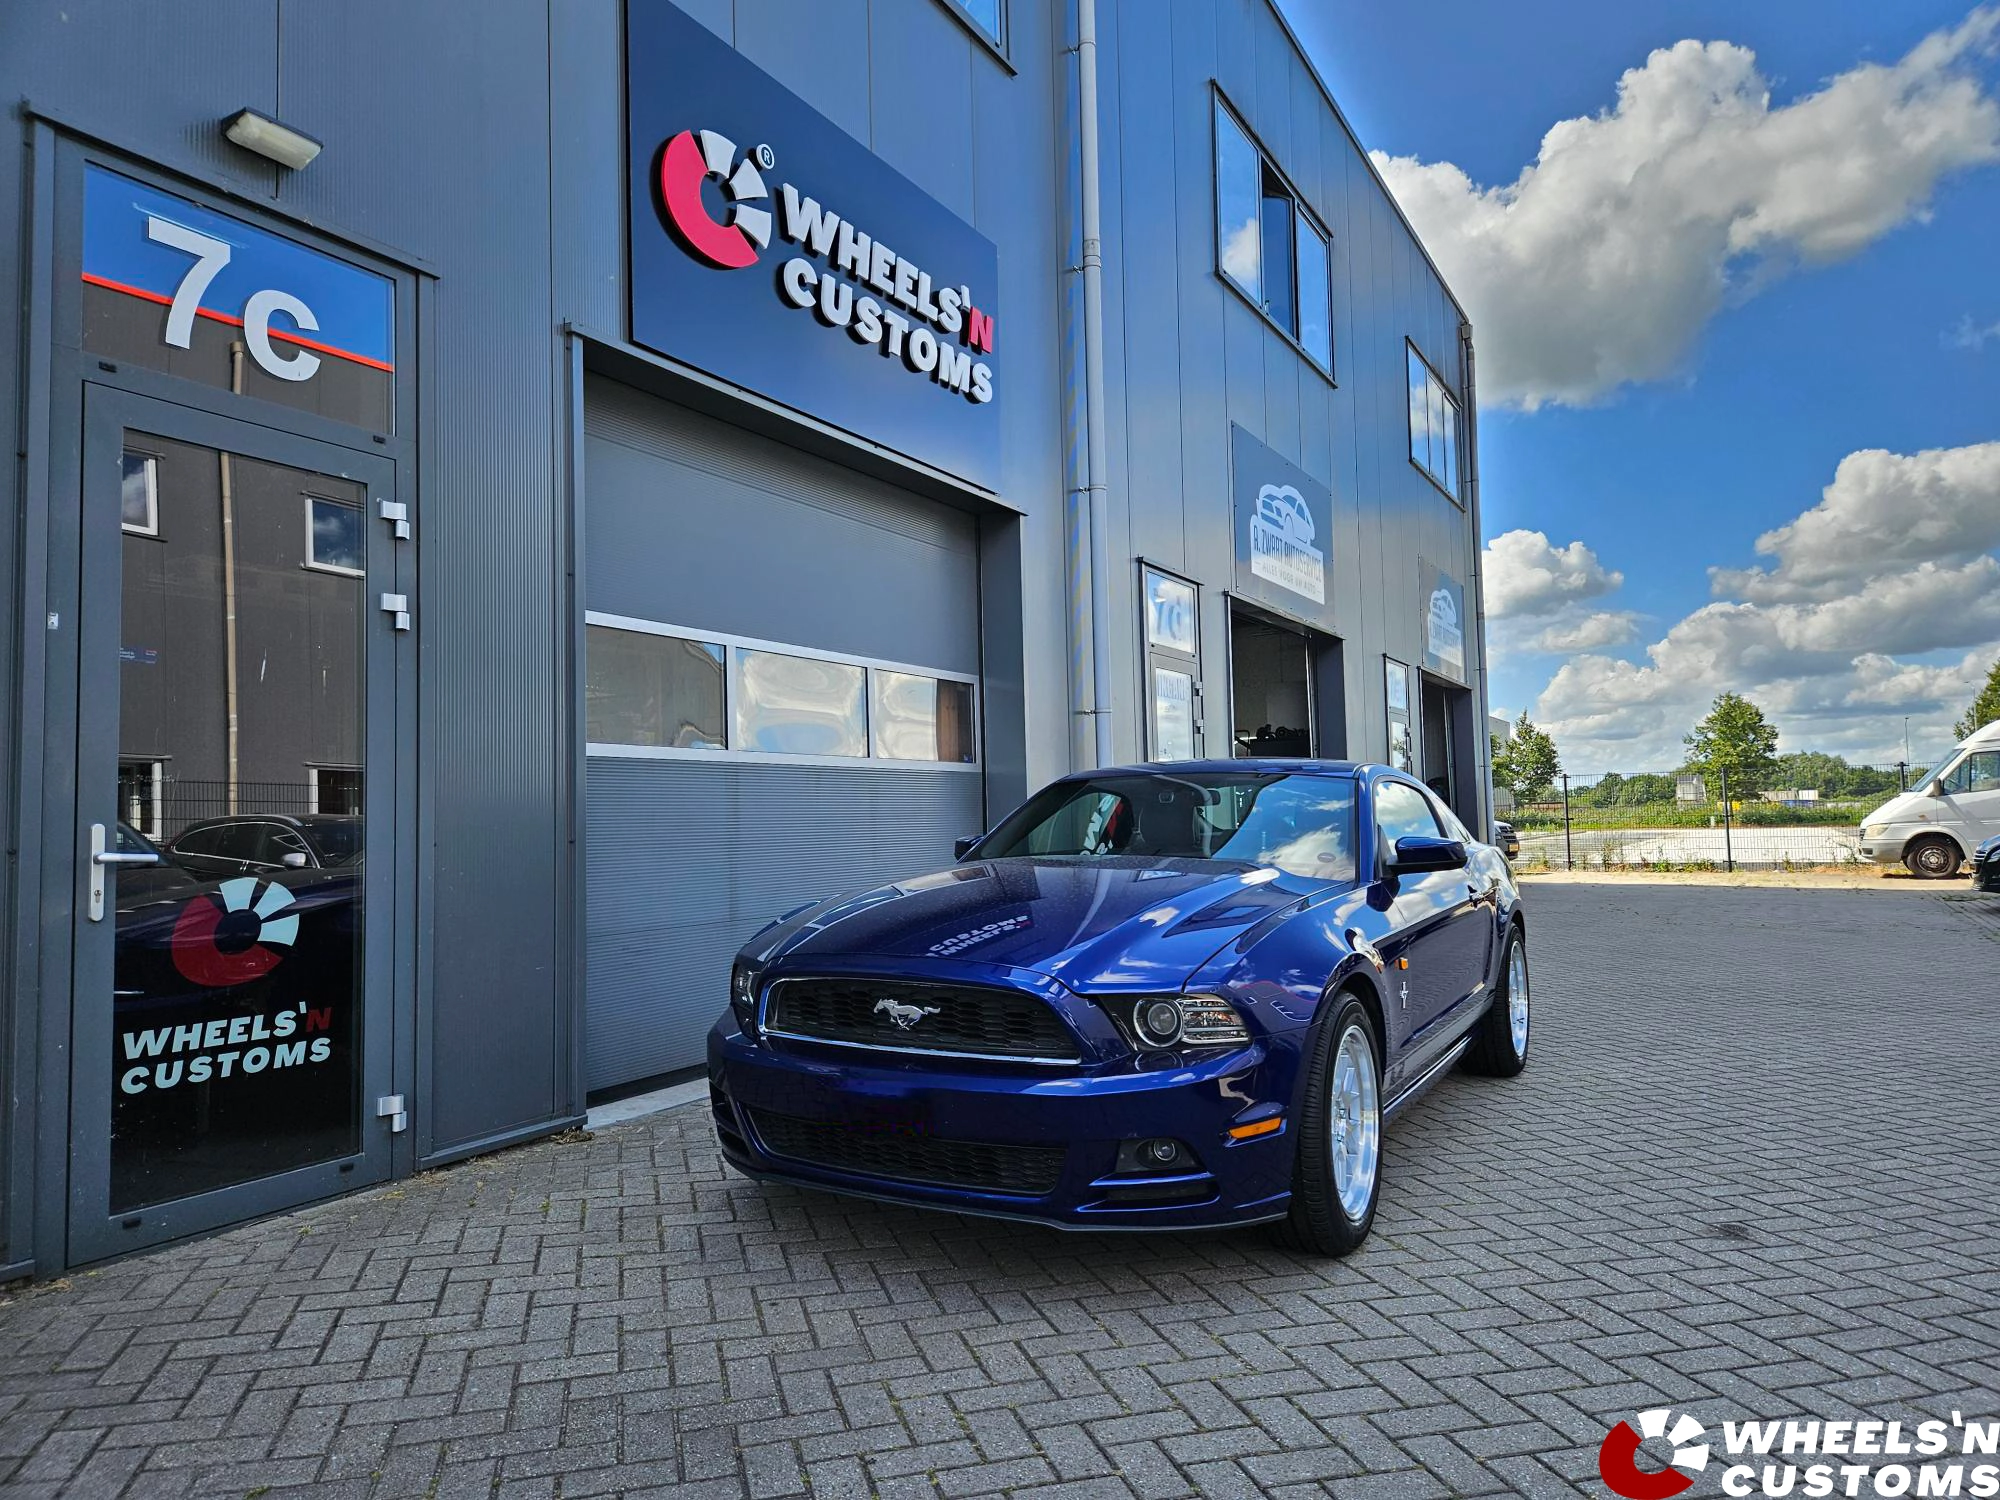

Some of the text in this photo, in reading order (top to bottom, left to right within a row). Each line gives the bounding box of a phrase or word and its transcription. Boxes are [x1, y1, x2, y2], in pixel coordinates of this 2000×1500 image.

[782, 183, 994, 354] WHEELS'N
[783, 257, 993, 403] CUSTOMS
[1262, 529, 1283, 564] ZWART
[123, 1001, 332, 1061] WHEELS'N
[120, 1037, 332, 1095] CUSTOMS
